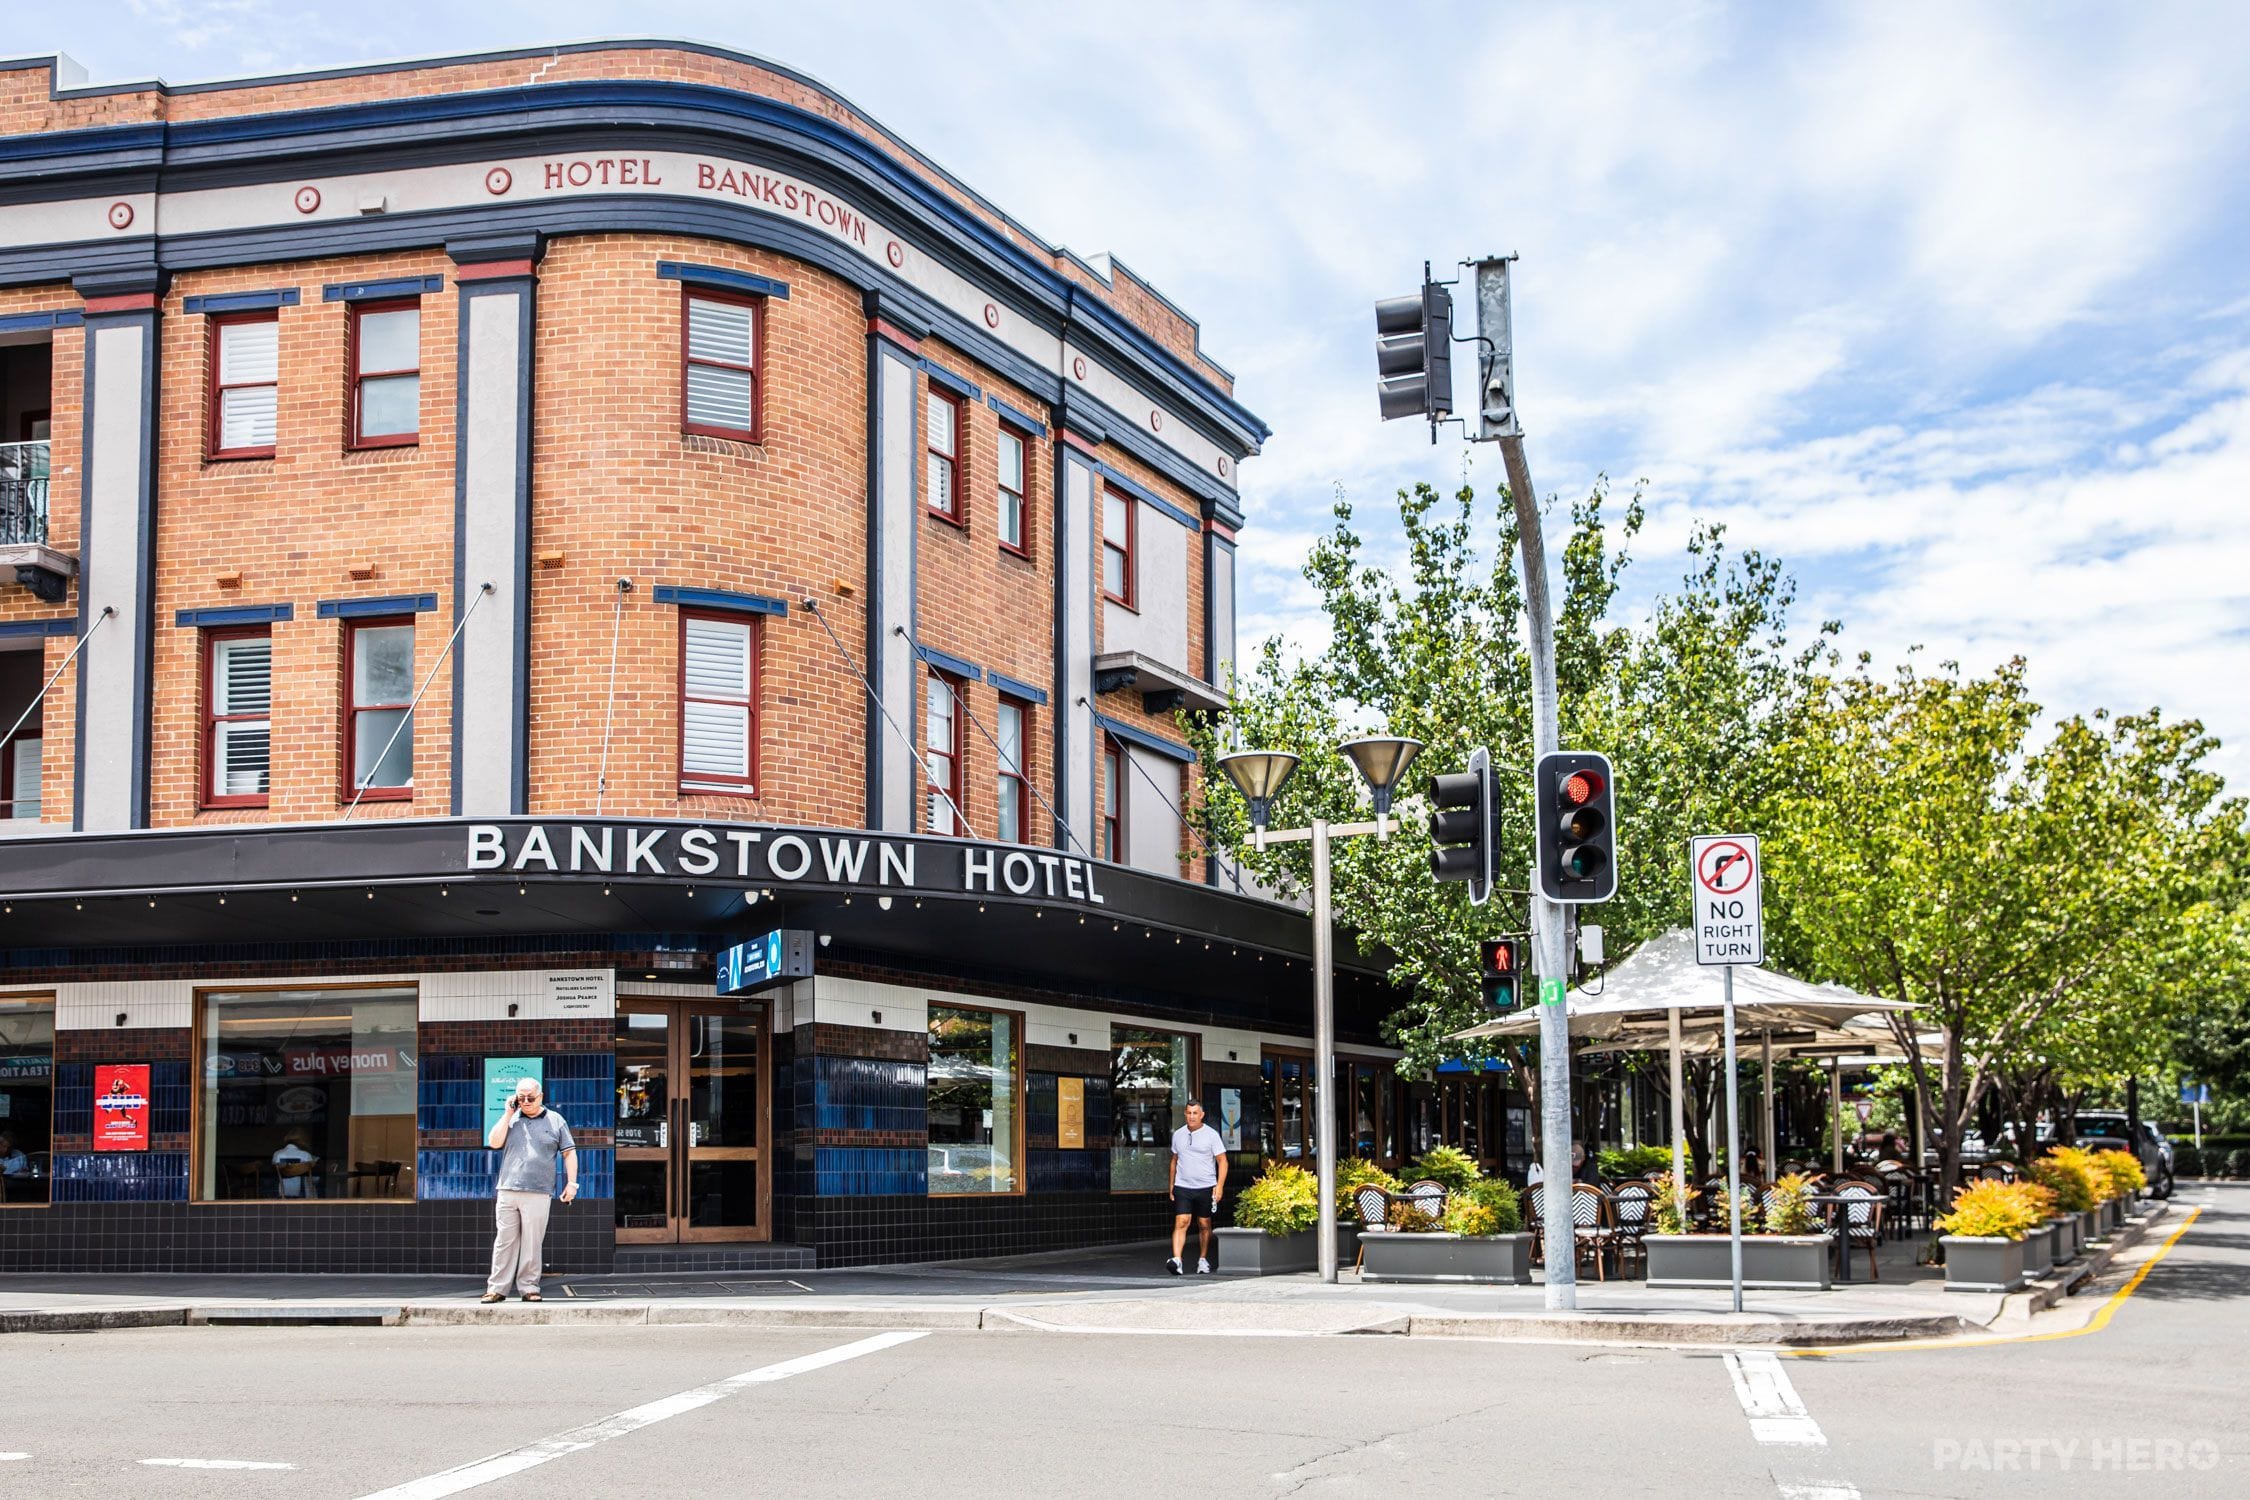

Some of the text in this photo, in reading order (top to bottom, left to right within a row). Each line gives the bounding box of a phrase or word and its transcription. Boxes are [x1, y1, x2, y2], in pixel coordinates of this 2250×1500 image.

[544, 159, 867, 246] HOTEL BANKSTOWN
[467, 825, 1104, 904] BANKSTOWN HOTEL
[1710, 901, 1744, 919] NO
[1704, 925, 1753, 938] RIGHT
[1706, 943, 1752, 956] TURN
